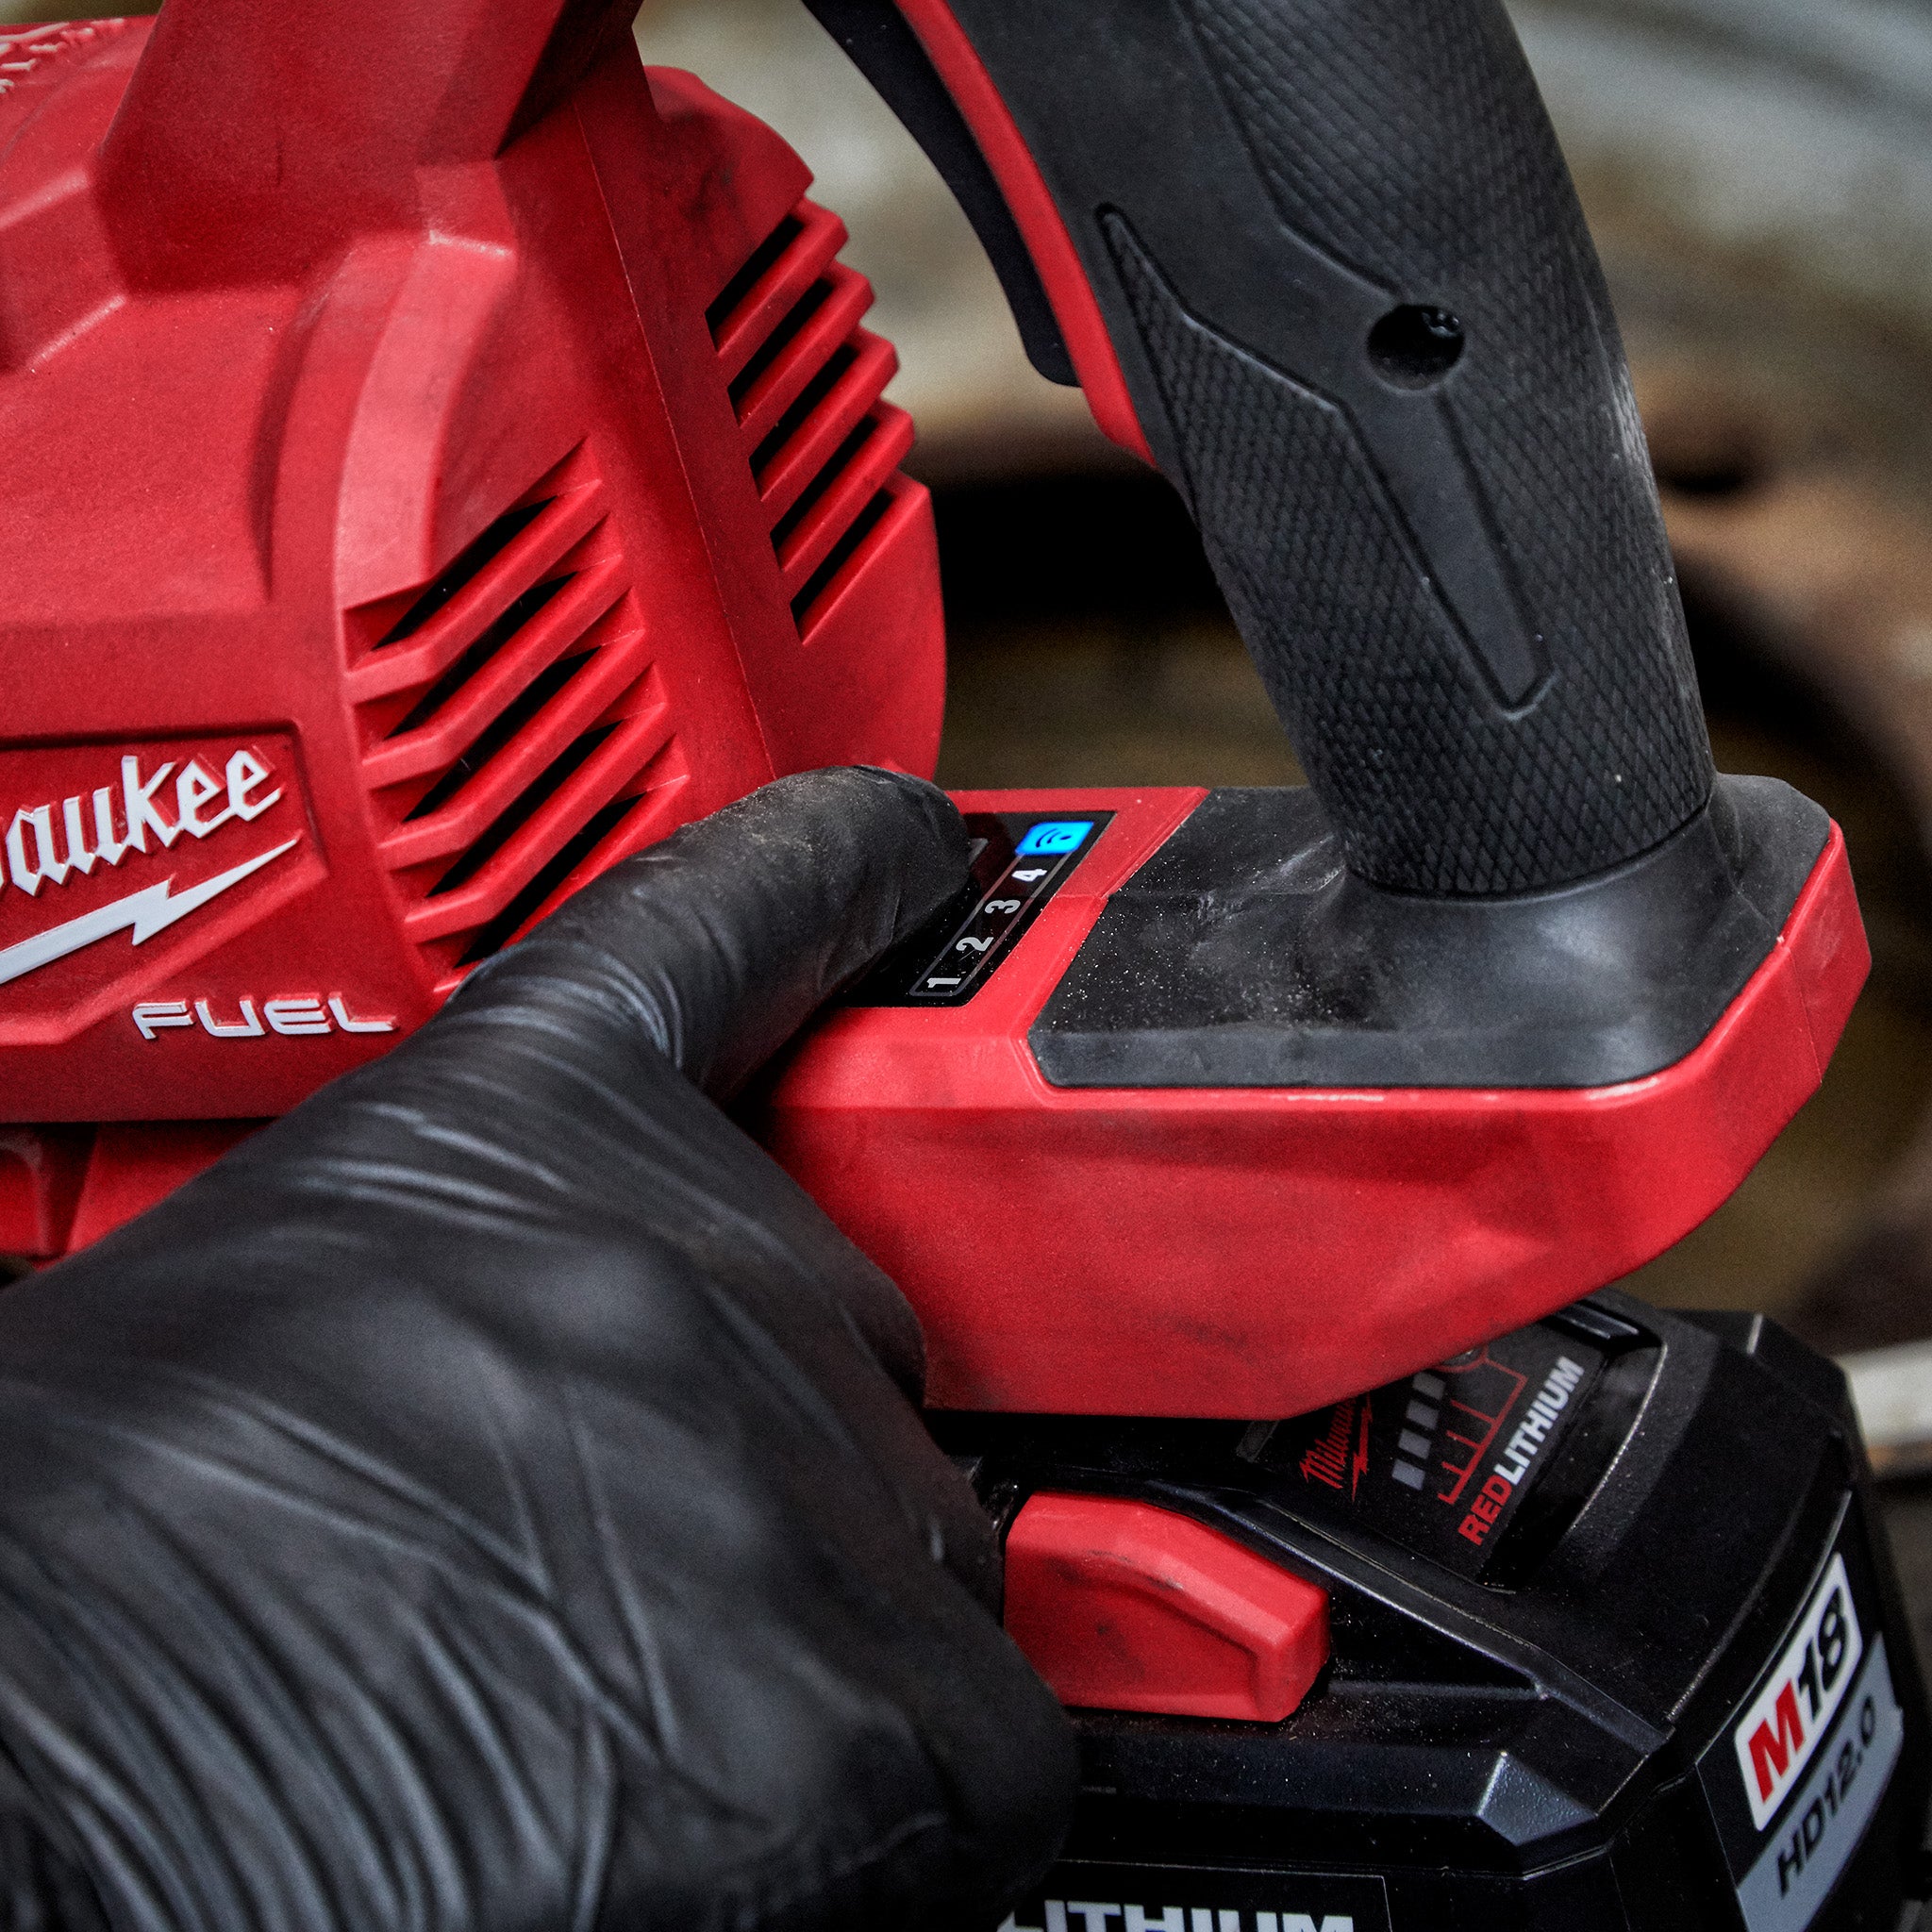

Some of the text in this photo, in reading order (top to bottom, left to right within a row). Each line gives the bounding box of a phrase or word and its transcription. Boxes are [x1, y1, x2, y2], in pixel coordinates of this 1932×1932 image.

[0, 750, 283, 896] aukee
[926, 868, 1047, 989] 1 2 3 4
[132, 993, 395, 1040] FUEL
[1457, 1356, 1585, 1546] REDLITHIUM
[1748, 1585, 1850, 1805] M18
[1777, 1693, 1875, 1900] HD12.0
